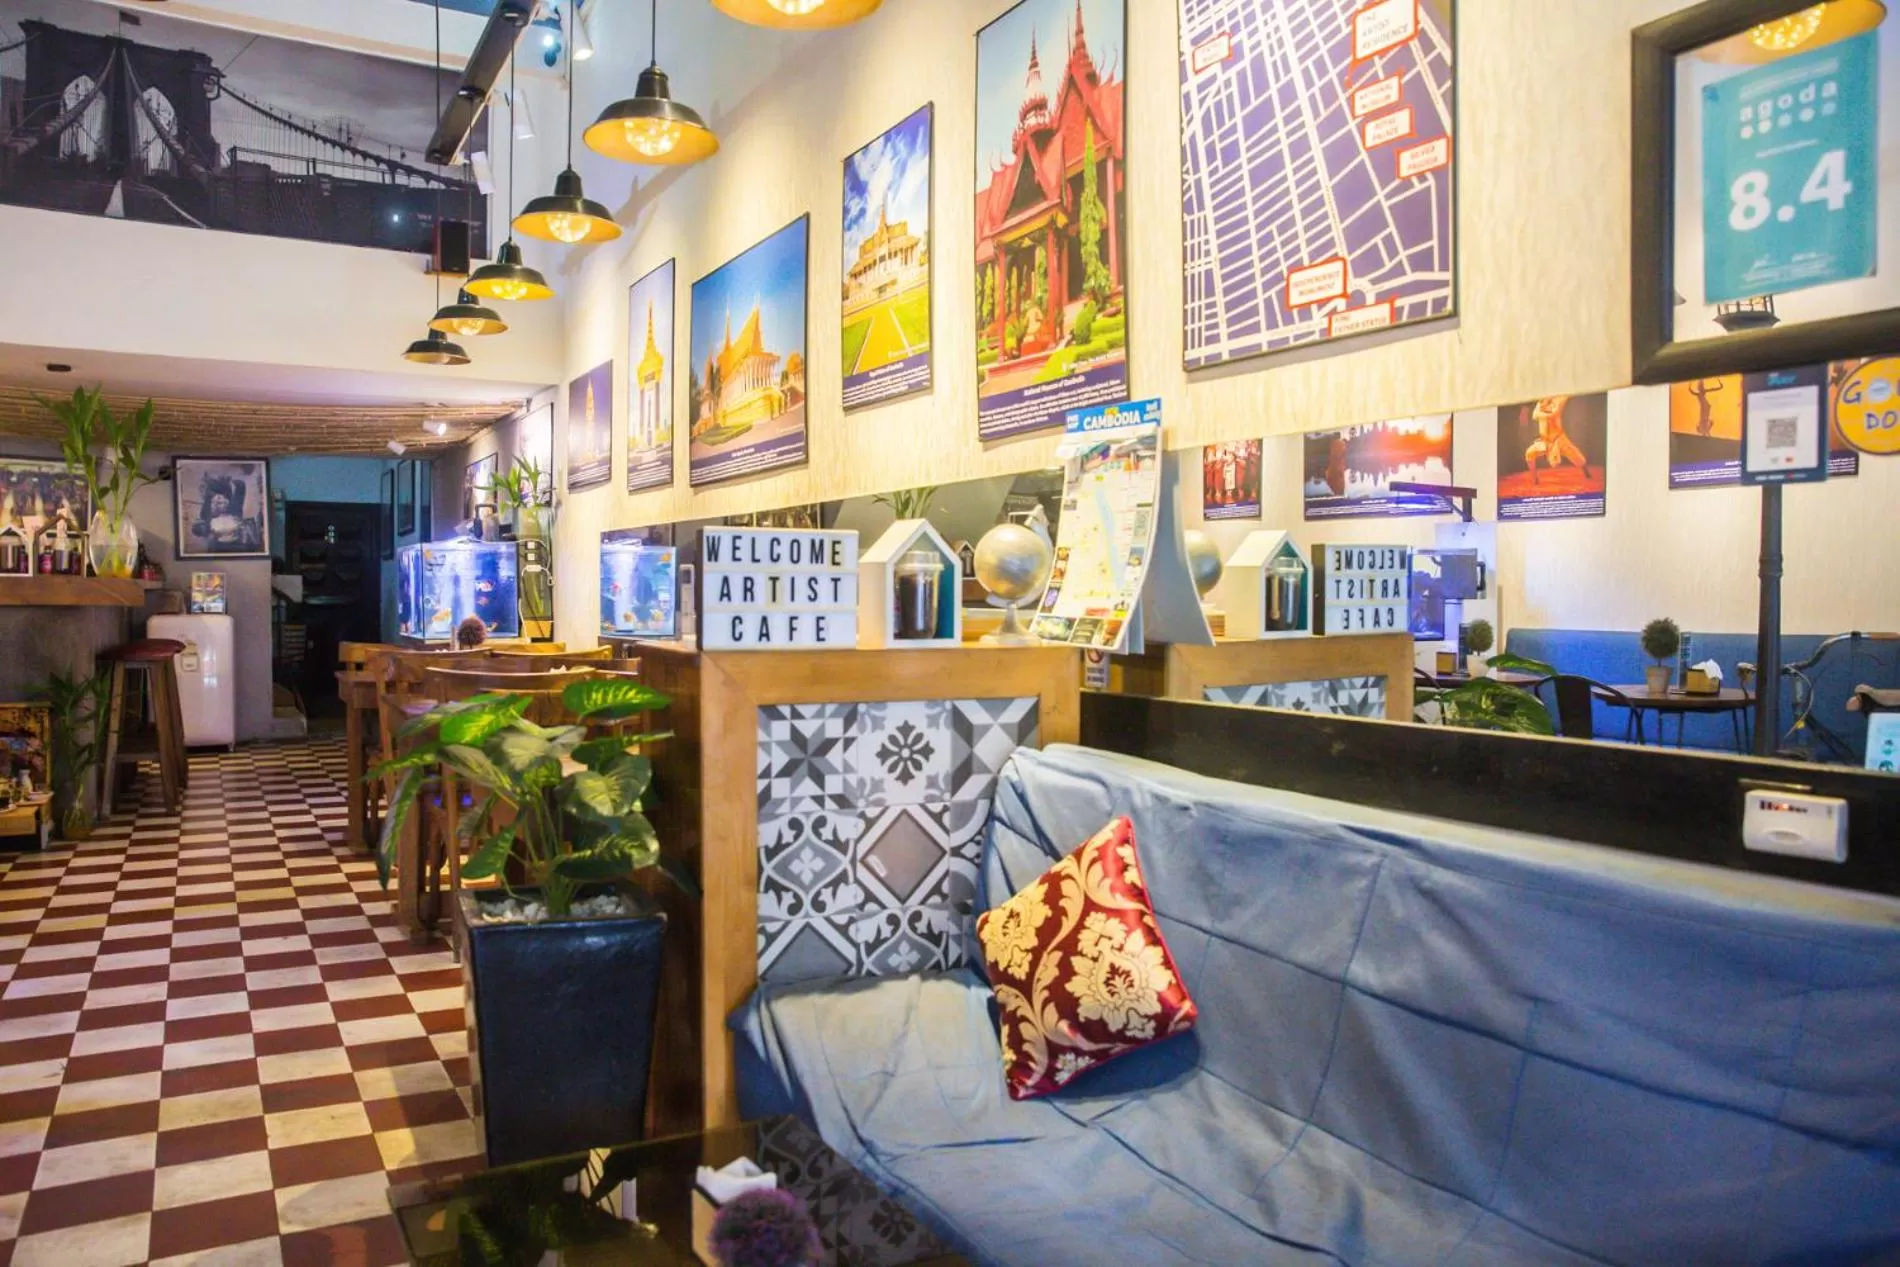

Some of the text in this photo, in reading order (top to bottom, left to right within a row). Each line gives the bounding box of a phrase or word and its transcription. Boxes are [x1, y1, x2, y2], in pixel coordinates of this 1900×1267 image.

[1740, 80, 1838, 122] agoda
[1729, 149, 1852, 231] 8.4
[1083, 409, 1141, 430] CAMBODIA
[706, 535, 842, 566] WELCOME
[719, 575, 841, 603] ARTIST
[731, 615, 826, 642] CAFE
